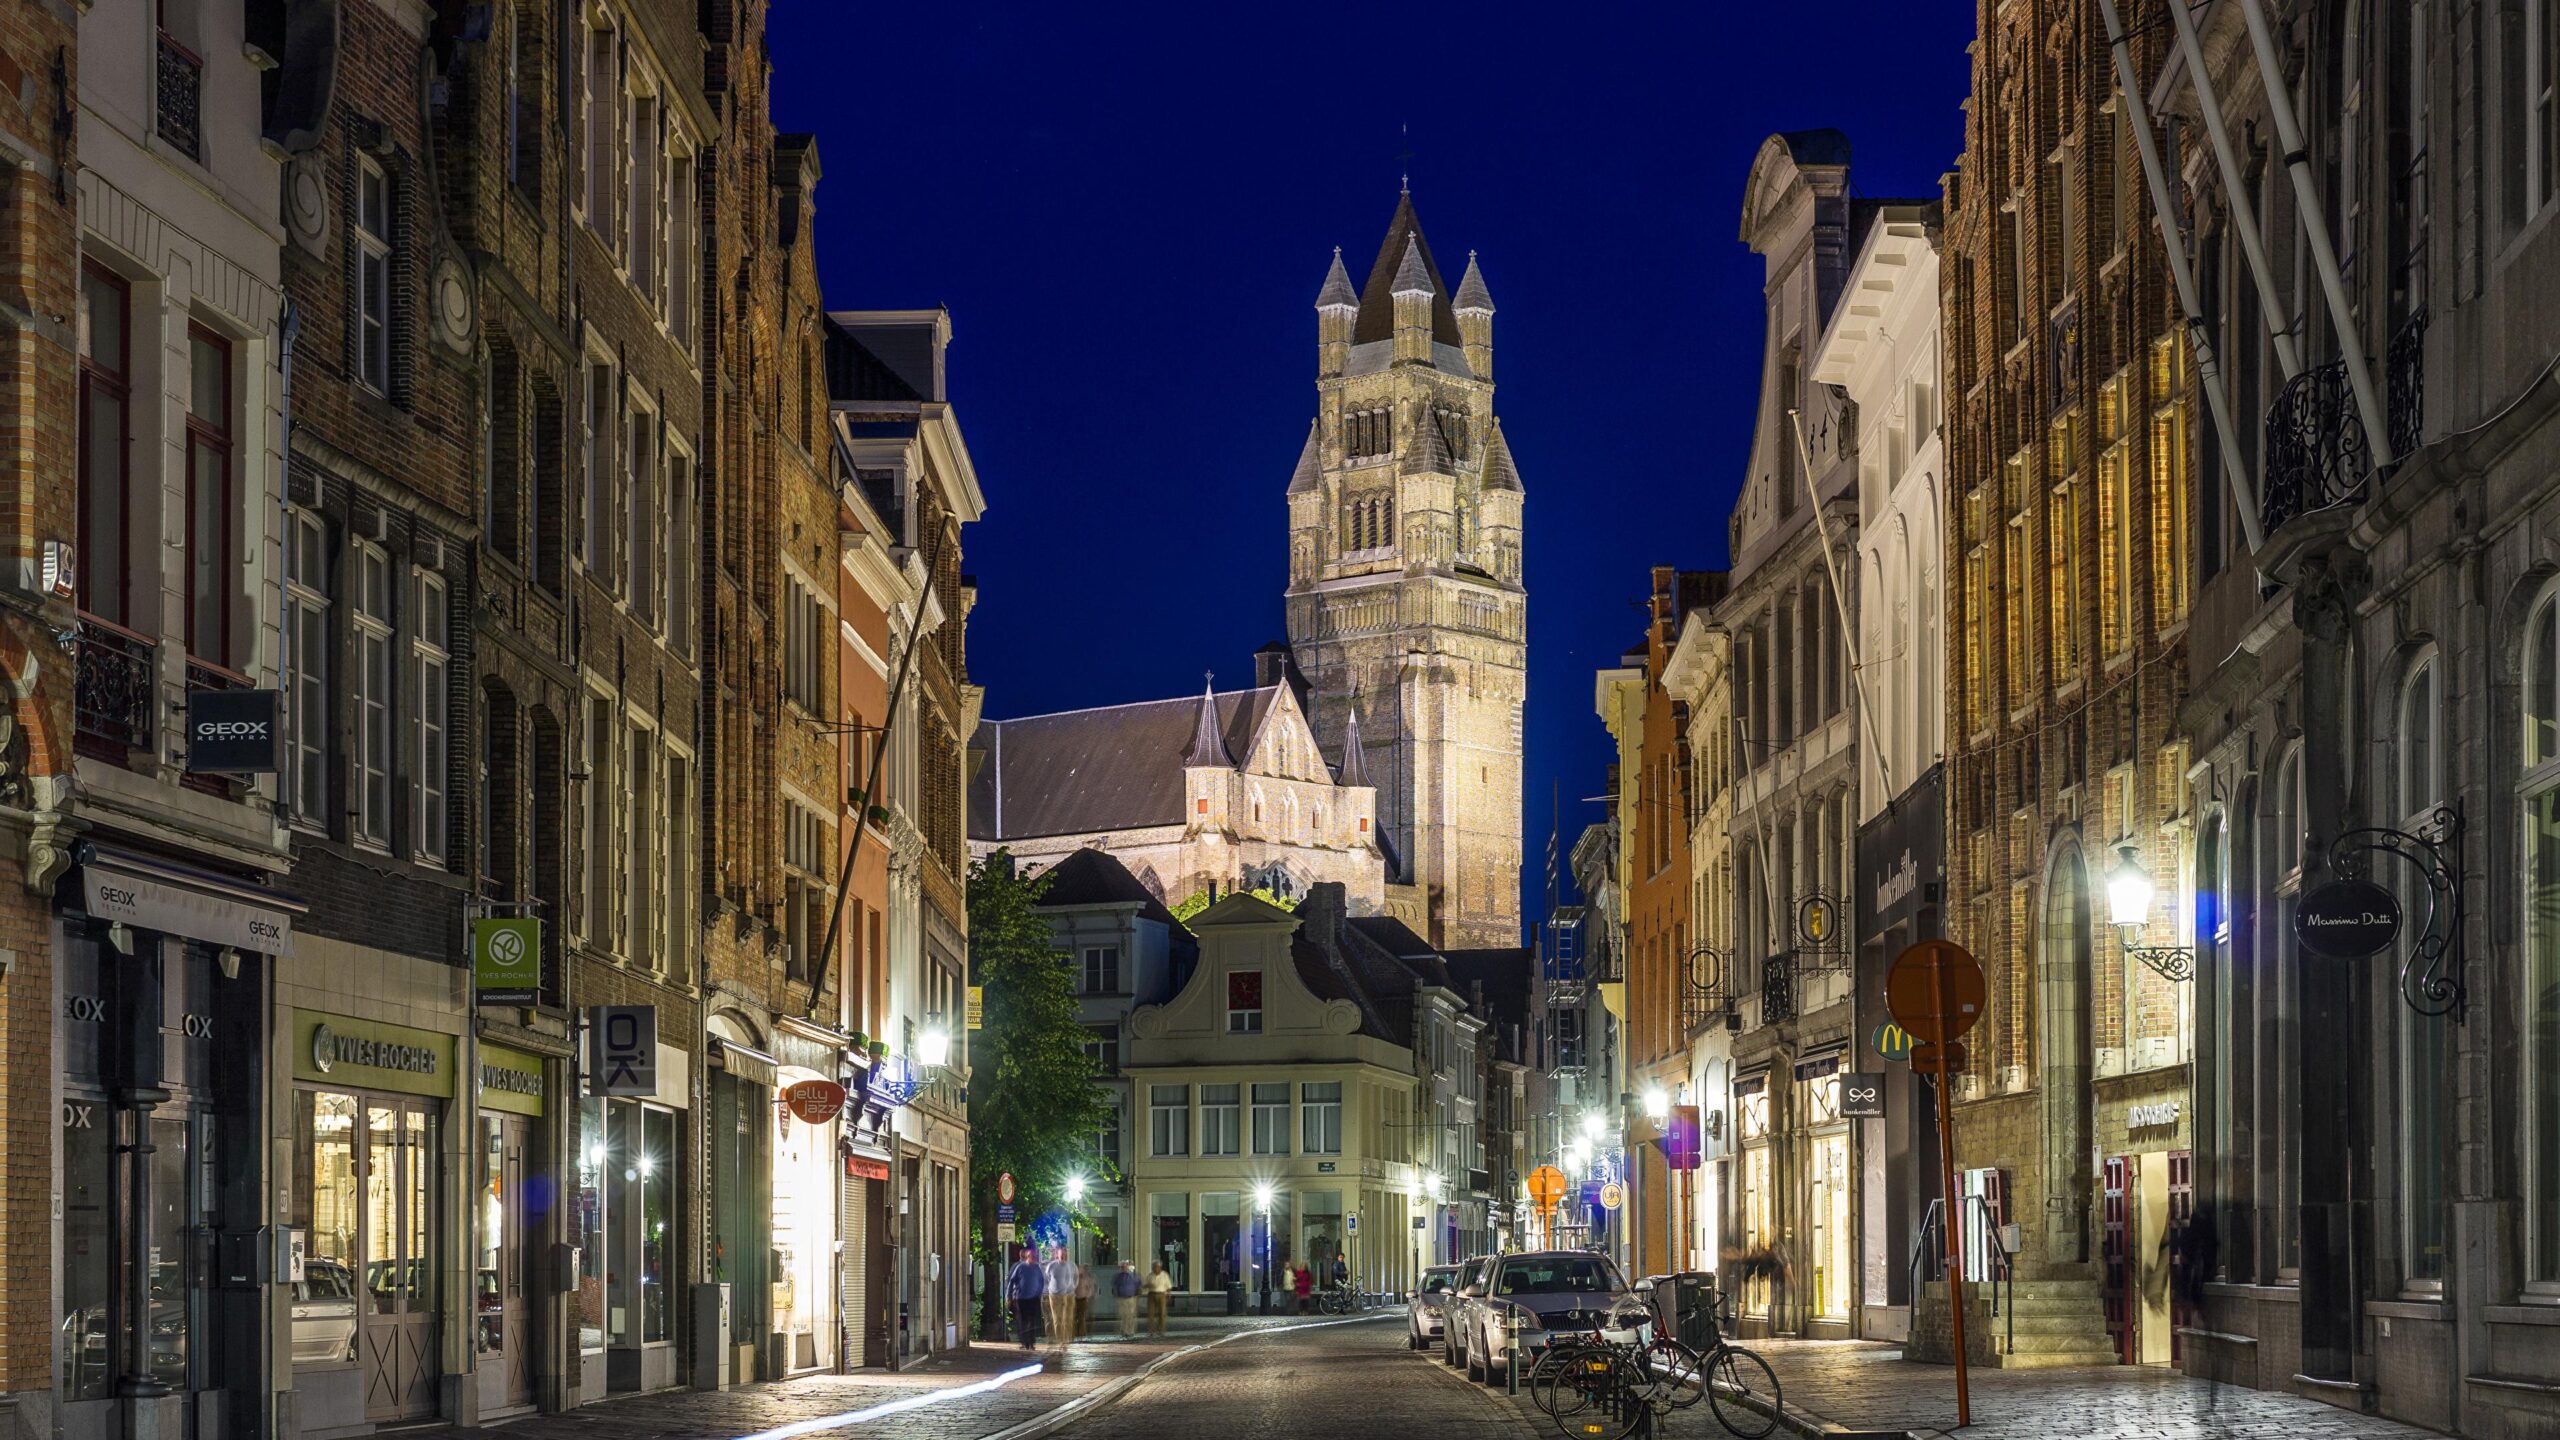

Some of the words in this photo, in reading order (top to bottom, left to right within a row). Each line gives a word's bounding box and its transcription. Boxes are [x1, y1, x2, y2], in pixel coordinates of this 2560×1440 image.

[197, 722, 268, 735] GEOX
[1876, 847, 1918, 915] hunkemöller
[100, 886, 136, 907] GEOX
[2307, 913, 2359, 926] Massimo
[2361, 912, 2392, 925] Dutti
[249, 920, 280, 940] GEOX
[335, 1035, 377, 1067] YVES
[378, 1042, 437, 1074] ROCHER
[485, 1064, 508, 1091] YVES
[510, 1068, 543, 1097] ROCHER
[790, 1086, 828, 1103] jelly
[802, 1100, 838, 1117] jazz
[1843, 1108, 1882, 1116] hunkemöller
